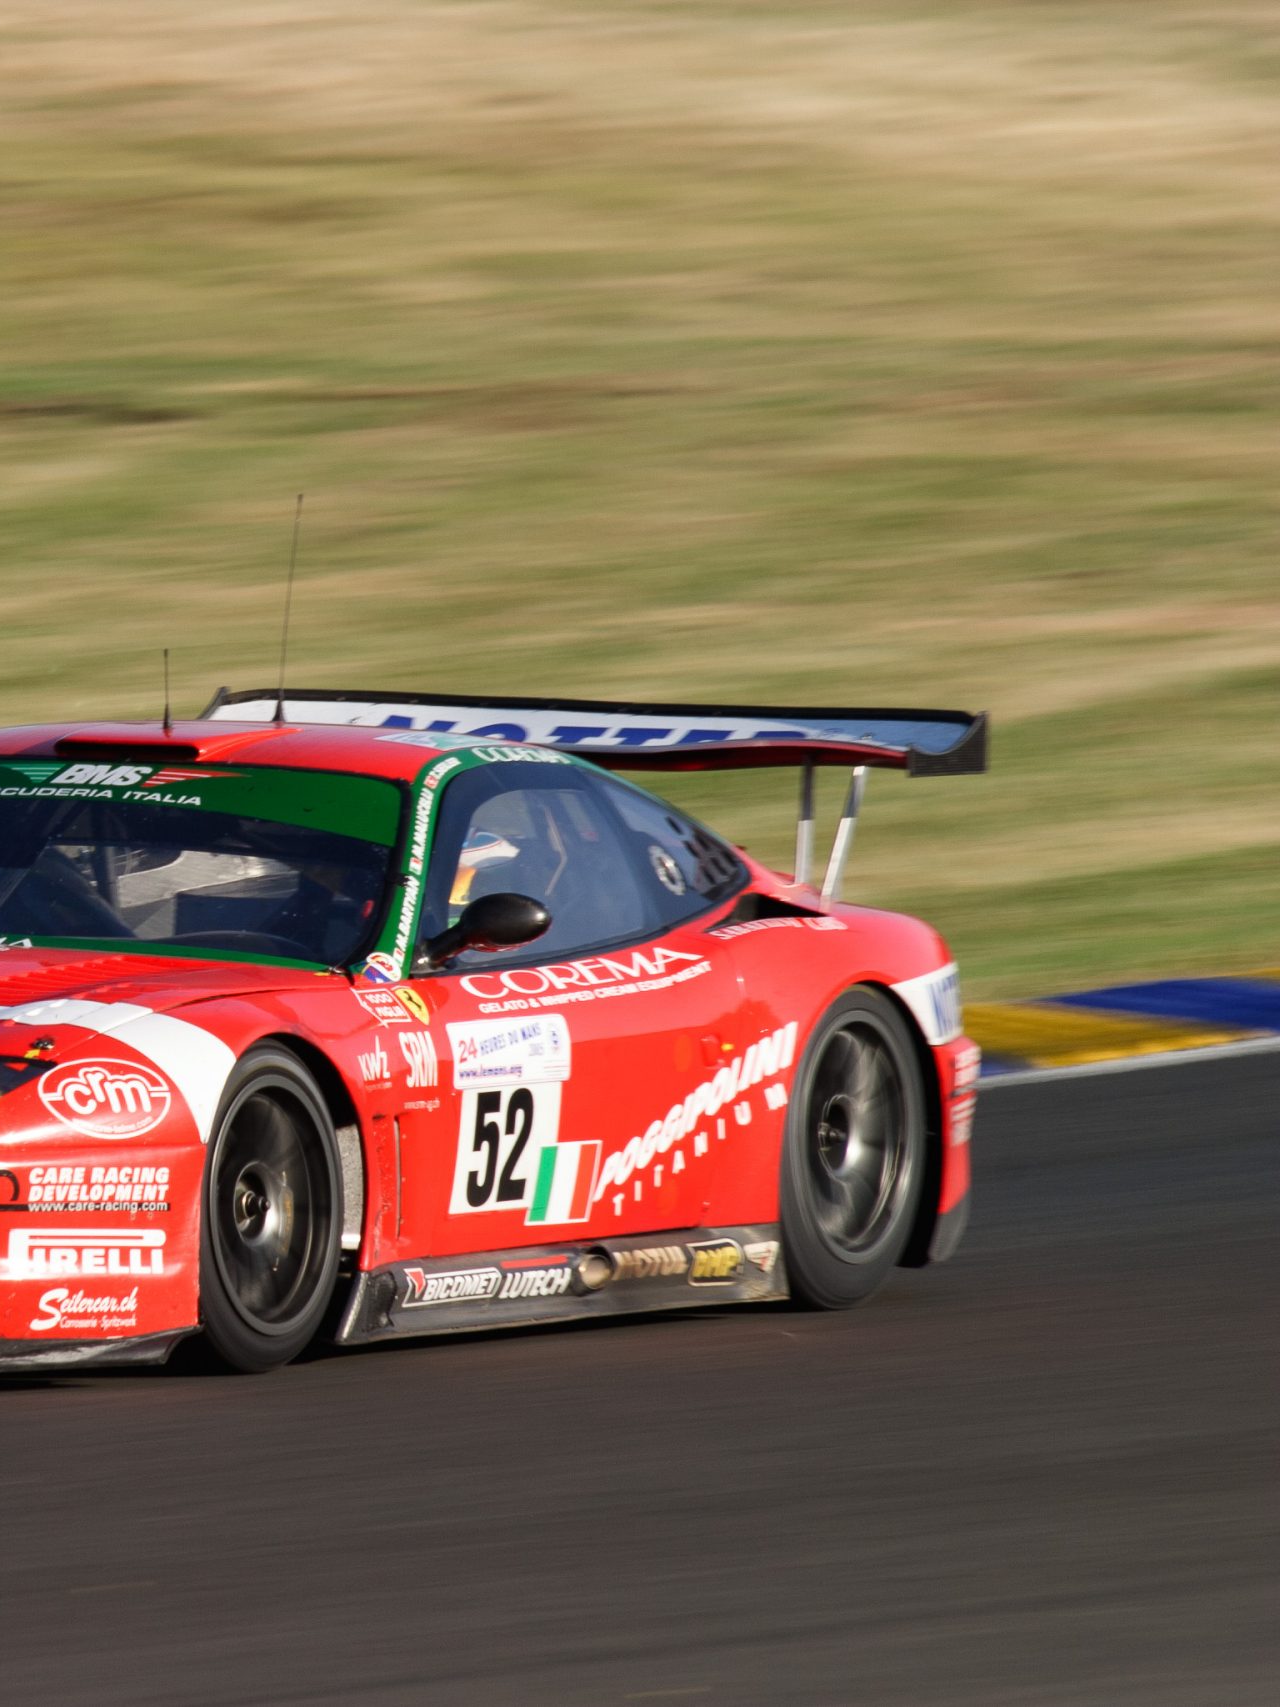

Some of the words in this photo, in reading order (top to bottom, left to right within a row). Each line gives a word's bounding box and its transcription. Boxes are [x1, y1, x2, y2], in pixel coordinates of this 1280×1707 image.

[49, 763, 153, 786] BMS
[122, 790, 202, 806] ITALIA
[459, 946, 705, 999] COREMA
[478, 999, 530, 1014] GELATO
[530, 998, 540, 1009] &
[540, 990, 595, 1007] WHIPPED
[594, 982, 638, 999] CREAM
[637, 960, 713, 992] EQUIPMENT
[398, 1030, 439, 1088] SRM
[458, 1037, 478, 1064] 24
[519, 1022, 542, 1041] MANS
[64, 1071, 152, 1115] crm
[591, 1021, 799, 1203] POGGIPOLINI
[466, 1087, 534, 1207] 52
[28, 1167, 86, 1184] CARE
[90, 1167, 170, 1184] RACING
[28, 1184, 169, 1202] DEVELOPMENT
[27, 1202, 169, 1214] www.care-racing.com
[8, 1228, 167, 1275] PIRELLI
[422, 1272, 498, 1301] BICOMET
[498, 1267, 572, 1300] LUTECH
